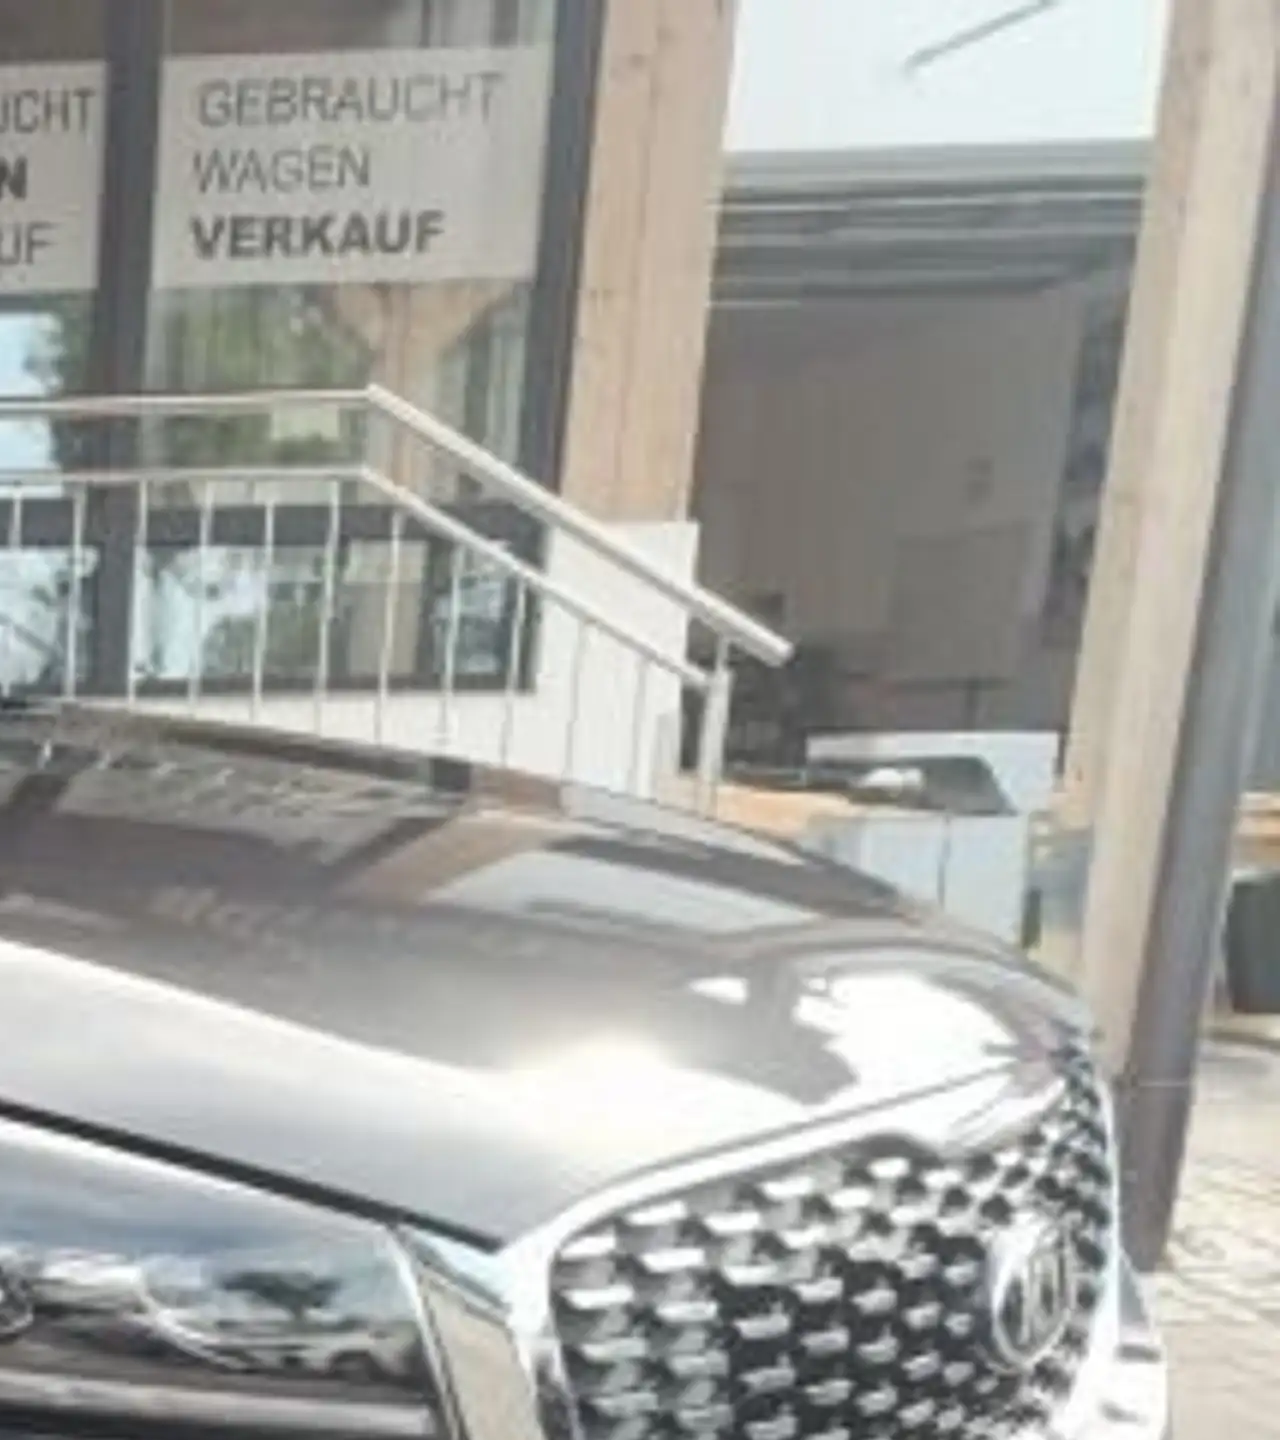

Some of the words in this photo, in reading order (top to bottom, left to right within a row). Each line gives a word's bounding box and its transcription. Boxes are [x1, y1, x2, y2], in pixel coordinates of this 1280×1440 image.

[195, 73, 504, 126] GEBRAUCHT
[194, 146, 371, 191] WAGEN
[191, 211, 445, 259] VERKAUF
